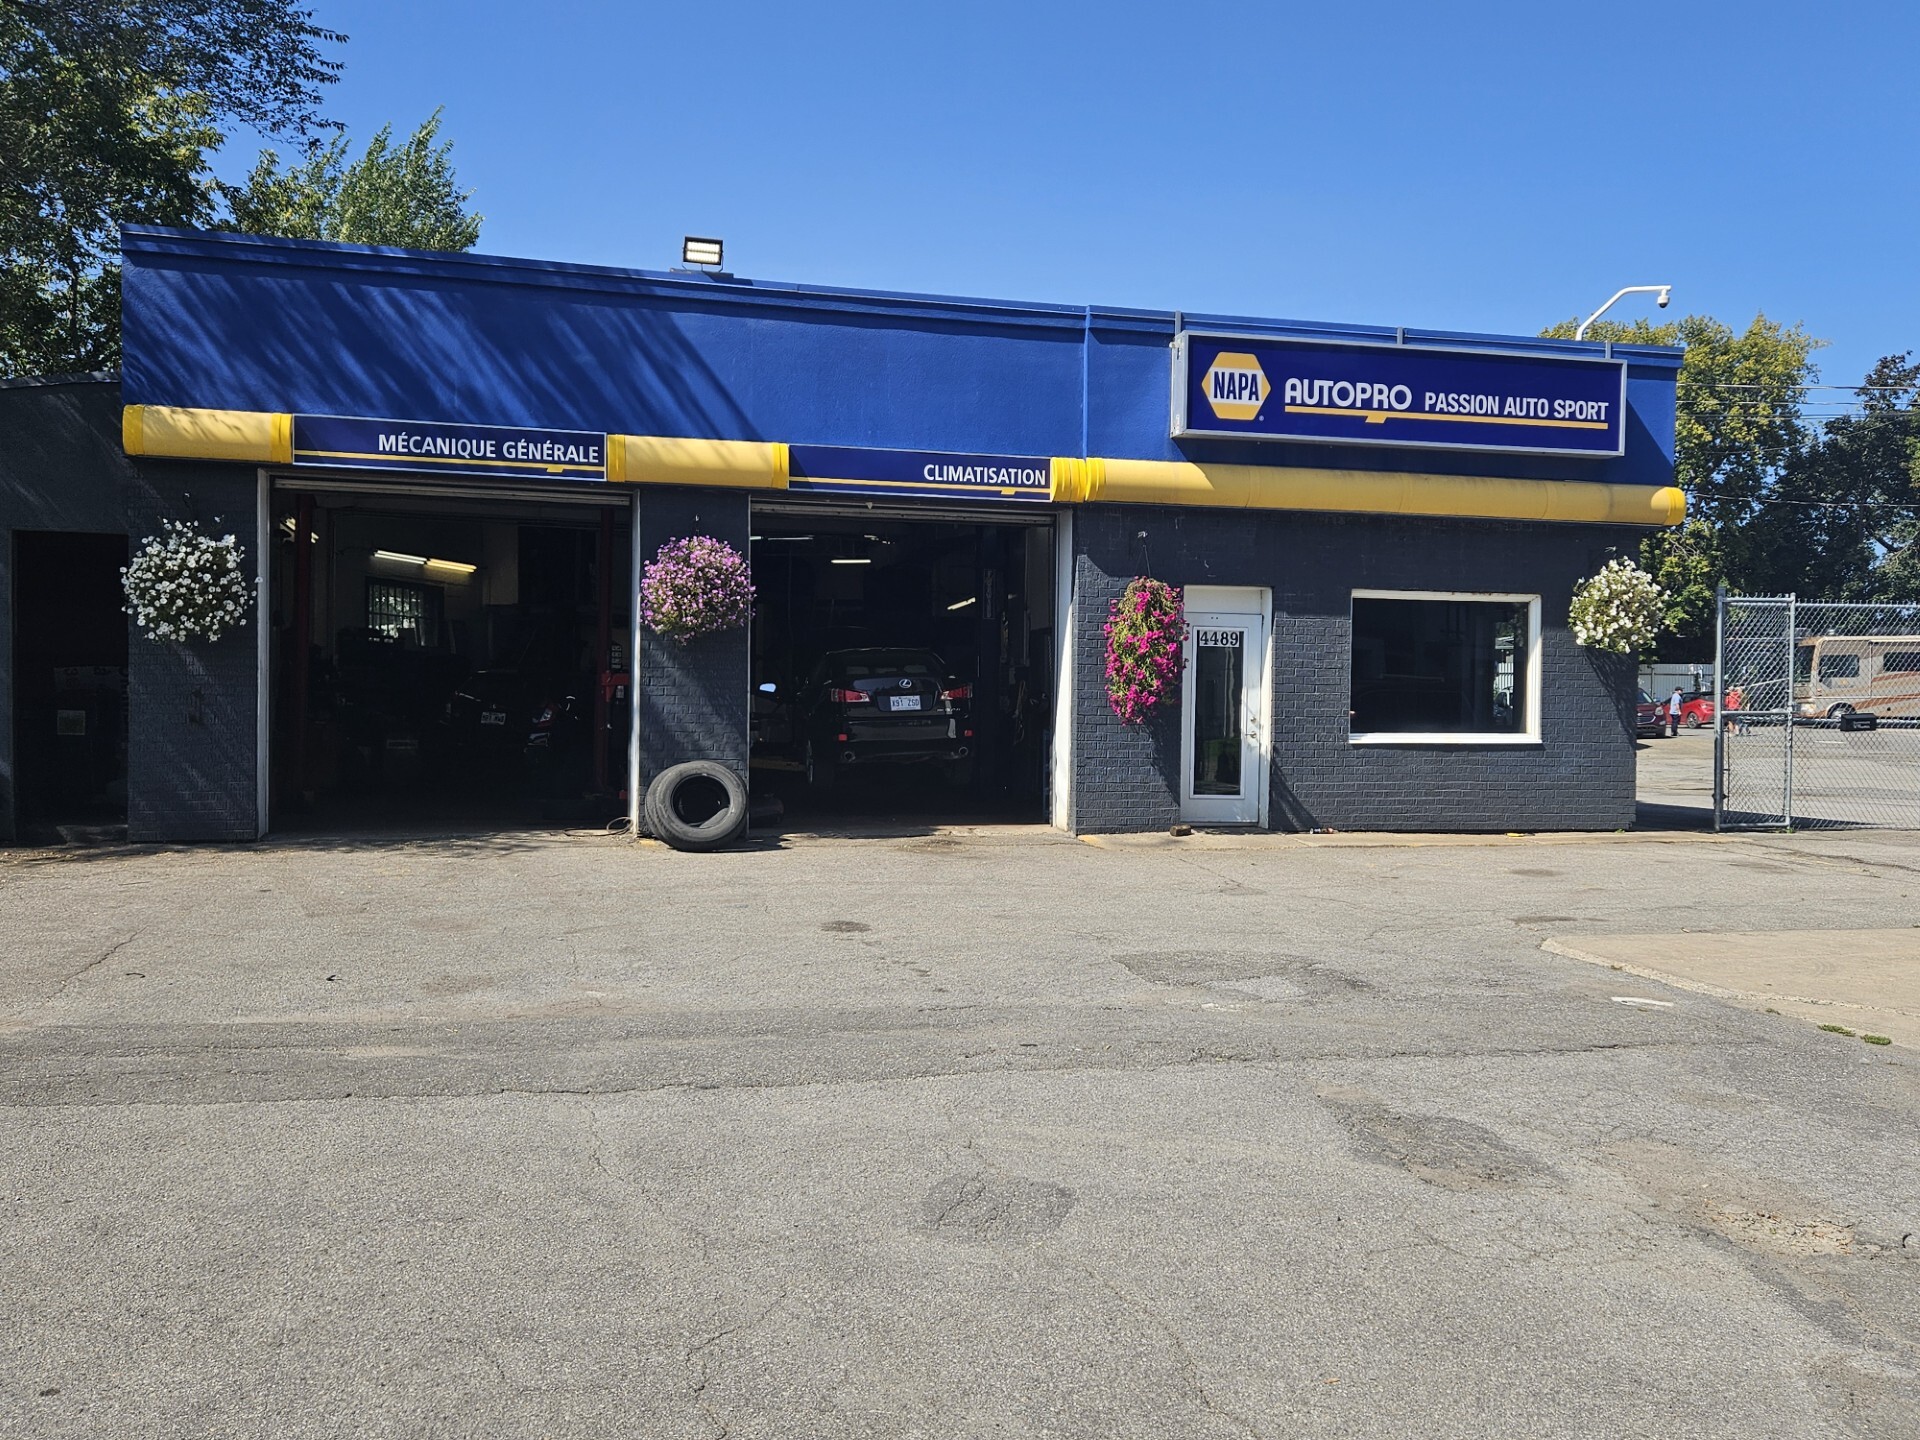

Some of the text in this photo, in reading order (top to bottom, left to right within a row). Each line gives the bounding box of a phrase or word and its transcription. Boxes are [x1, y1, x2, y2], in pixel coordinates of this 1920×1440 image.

[1213, 371, 1260, 402] NAPA
[1284, 377, 1609, 421] AUTOPRO PASSION AUTO SPORT
[378, 431, 599, 463] MÉCANIQUE GÉNÉRALE
[923, 463, 1046, 486] CLIMATISATION
[1199, 630, 1240, 646] 4489
